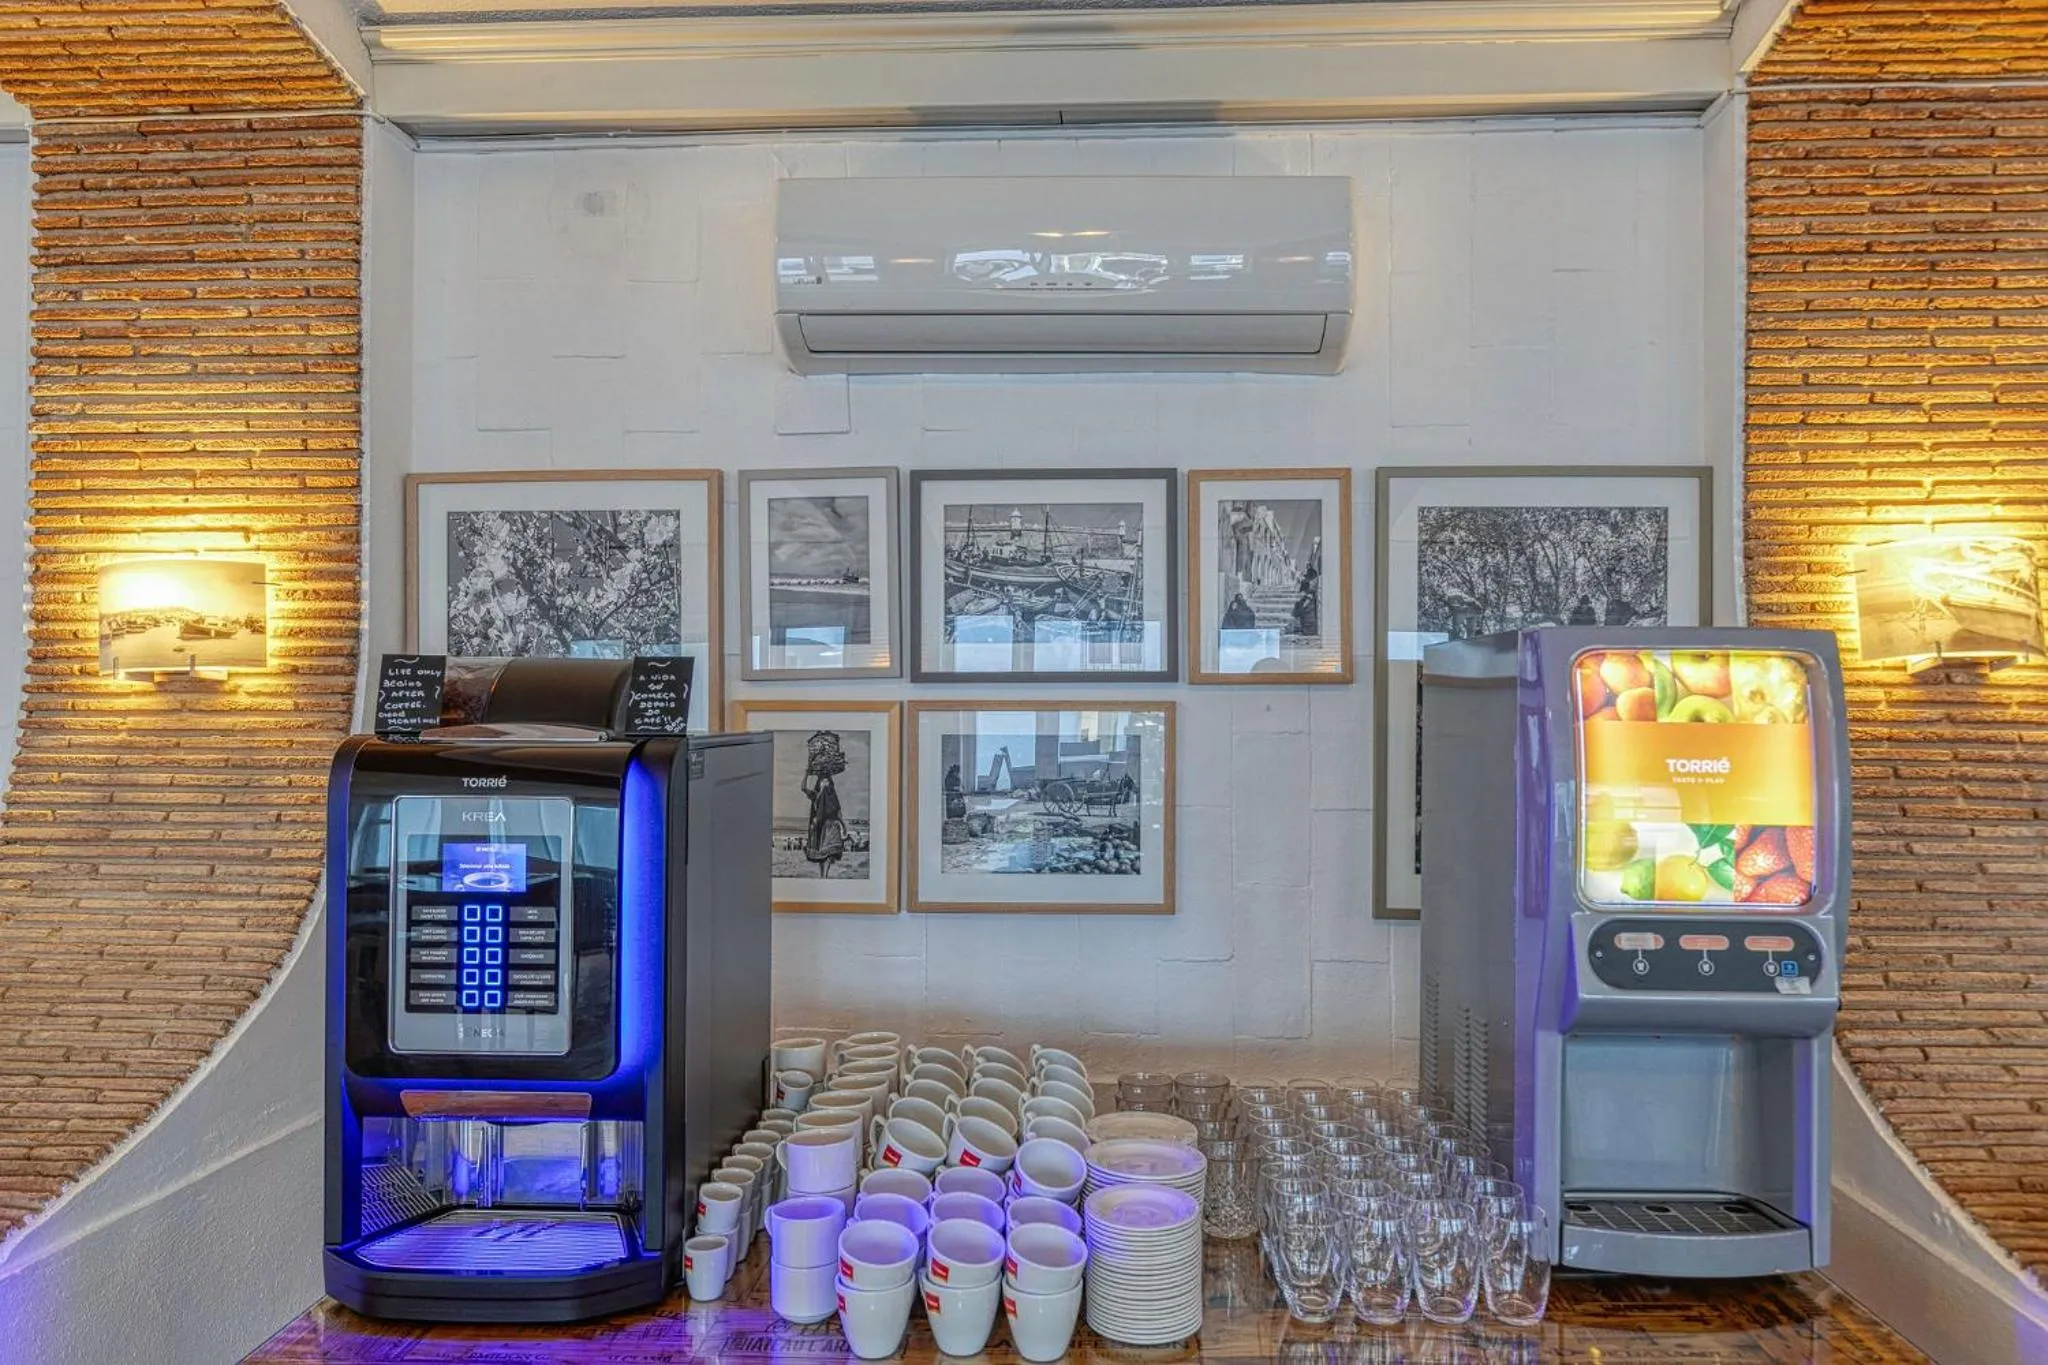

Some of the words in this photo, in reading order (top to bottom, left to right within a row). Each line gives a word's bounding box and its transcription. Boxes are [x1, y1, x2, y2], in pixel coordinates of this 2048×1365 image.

[388, 668, 412, 676] LIFE
[417, 669, 442, 678] ONLY
[391, 690, 425, 698] AFTER
[639, 701, 676, 709] DEPOIS
